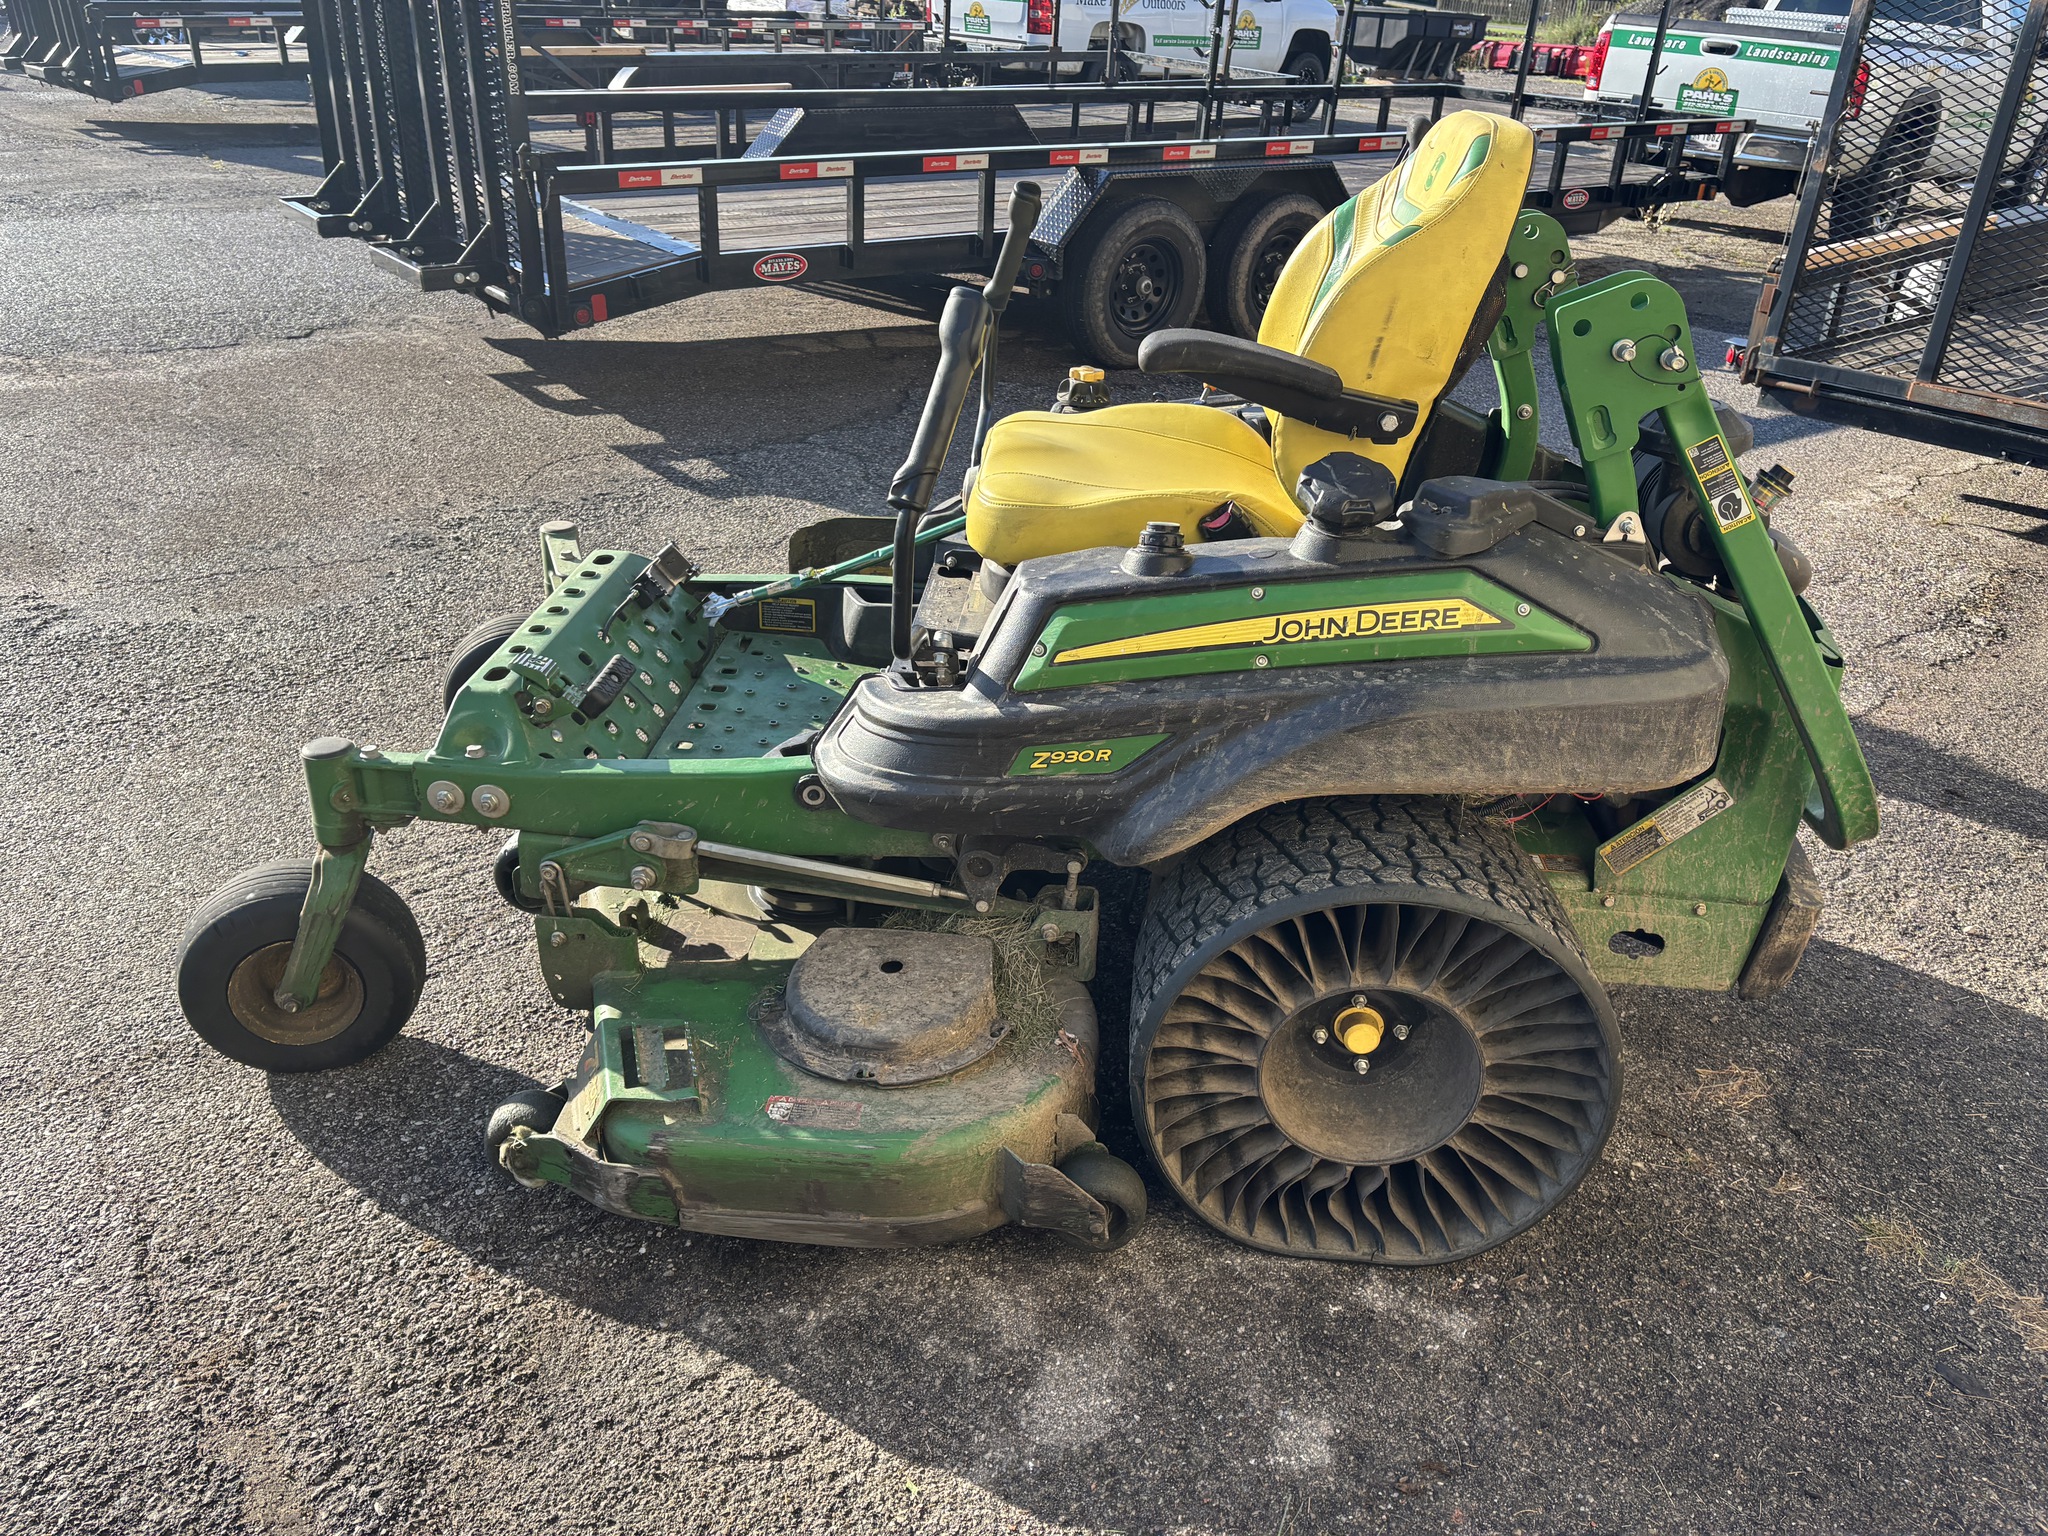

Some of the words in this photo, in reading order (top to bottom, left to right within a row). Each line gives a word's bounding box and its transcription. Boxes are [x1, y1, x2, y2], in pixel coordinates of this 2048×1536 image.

[1628, 33, 1687, 50] Laware
[1746, 44, 1830, 67] Landscaping
[1682, 89, 1734, 103] PAHL'S
[761, 260, 800, 273] MAYES
[1723, 516, 1749, 531] CAUTION
[1263, 616, 1348, 641] JOHN
[1356, 607, 1461, 633] DEERE
